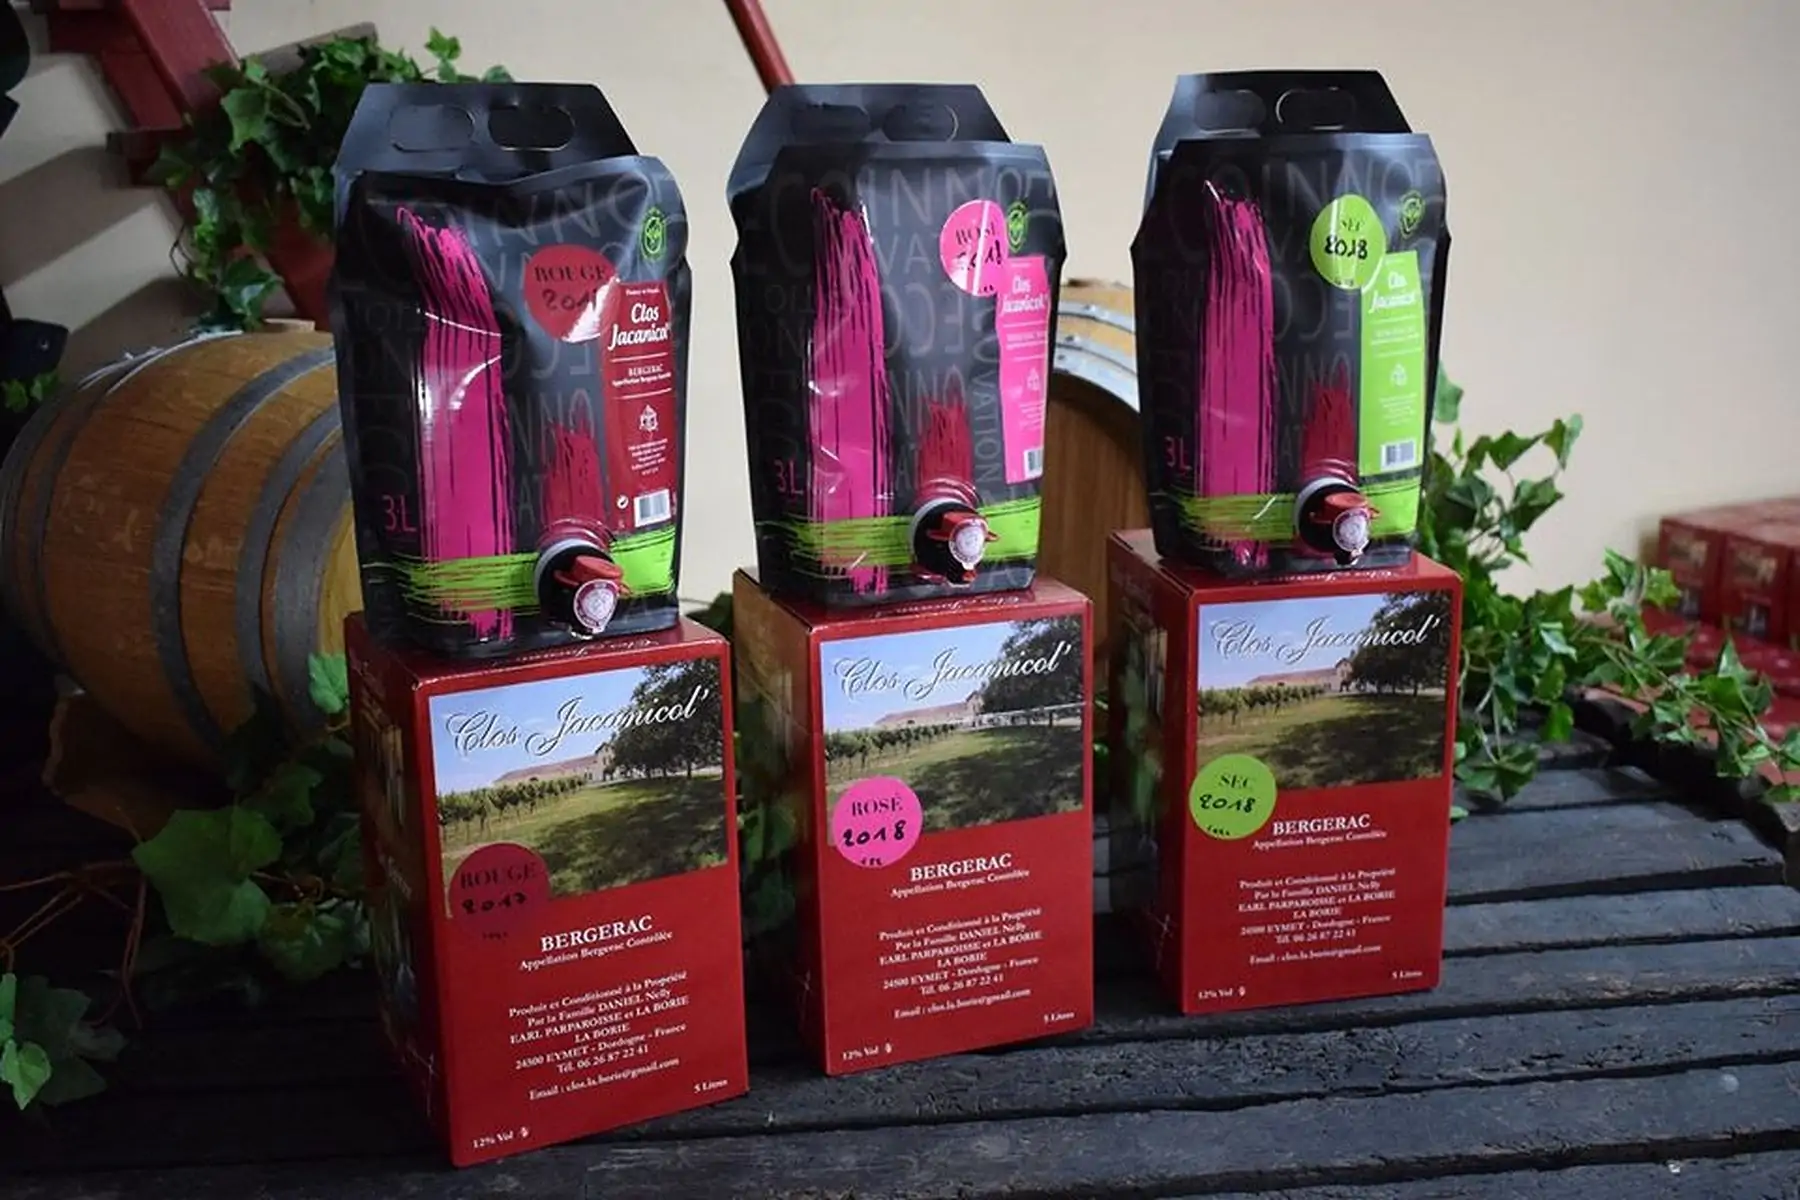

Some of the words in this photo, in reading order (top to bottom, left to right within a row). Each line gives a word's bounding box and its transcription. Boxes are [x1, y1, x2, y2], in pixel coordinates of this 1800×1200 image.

[534, 264, 607, 282] ROUGE
[631, 303, 660, 324] Clos
[1210, 616, 1272, 660] Clos
[834, 656, 901, 702] Clos
[446, 709, 521, 755] Clos
[1200, 794, 1256, 813] 2018
[843, 819, 906, 847] 2018
[1272, 814, 1371, 836] BERGERAC
[1252, 838, 1304, 851] Appellation
[1306, 835, 1343, 847] Bergerac
[910, 853, 1012, 882] BERGERAC
[890, 882, 944, 898] Appellation
[946, 876, 986, 890] Bergerac
[541, 915, 653, 952] BERGERAC
[519, 952, 578, 971] Appellation
[581, 943, 625, 958] Bergerac
[509, 1003, 547, 1018] Produit
[550, 1001, 560, 1009] et
[625, 984, 631, 992] à
[633, 981, 642, 991] la
[527, 1016, 545, 1028] Par
[547, 1014, 556, 1023] la
[559, 1007, 596, 1021] Famille
[598, 996, 644, 1013] DANIEL
[646, 989, 672, 1001] Nelly
[510, 1030, 543, 1045] EARL
[624, 1011, 634, 1020] et
[636, 1005, 651, 1017] LA
[653, 996, 690, 1013] BORIE
[575, 1032, 590, 1043] LA
[593, 1023, 631, 1039] BORIE
[546, 1045, 589, 1062] EYMET
[598, 1034, 646, 1051] Dordogne
[654, 1024, 686, 1037] France
[593, 1055, 606, 1065] 26
[622, 1048, 635, 1058] 22
[529, 1085, 559, 1100] Email
